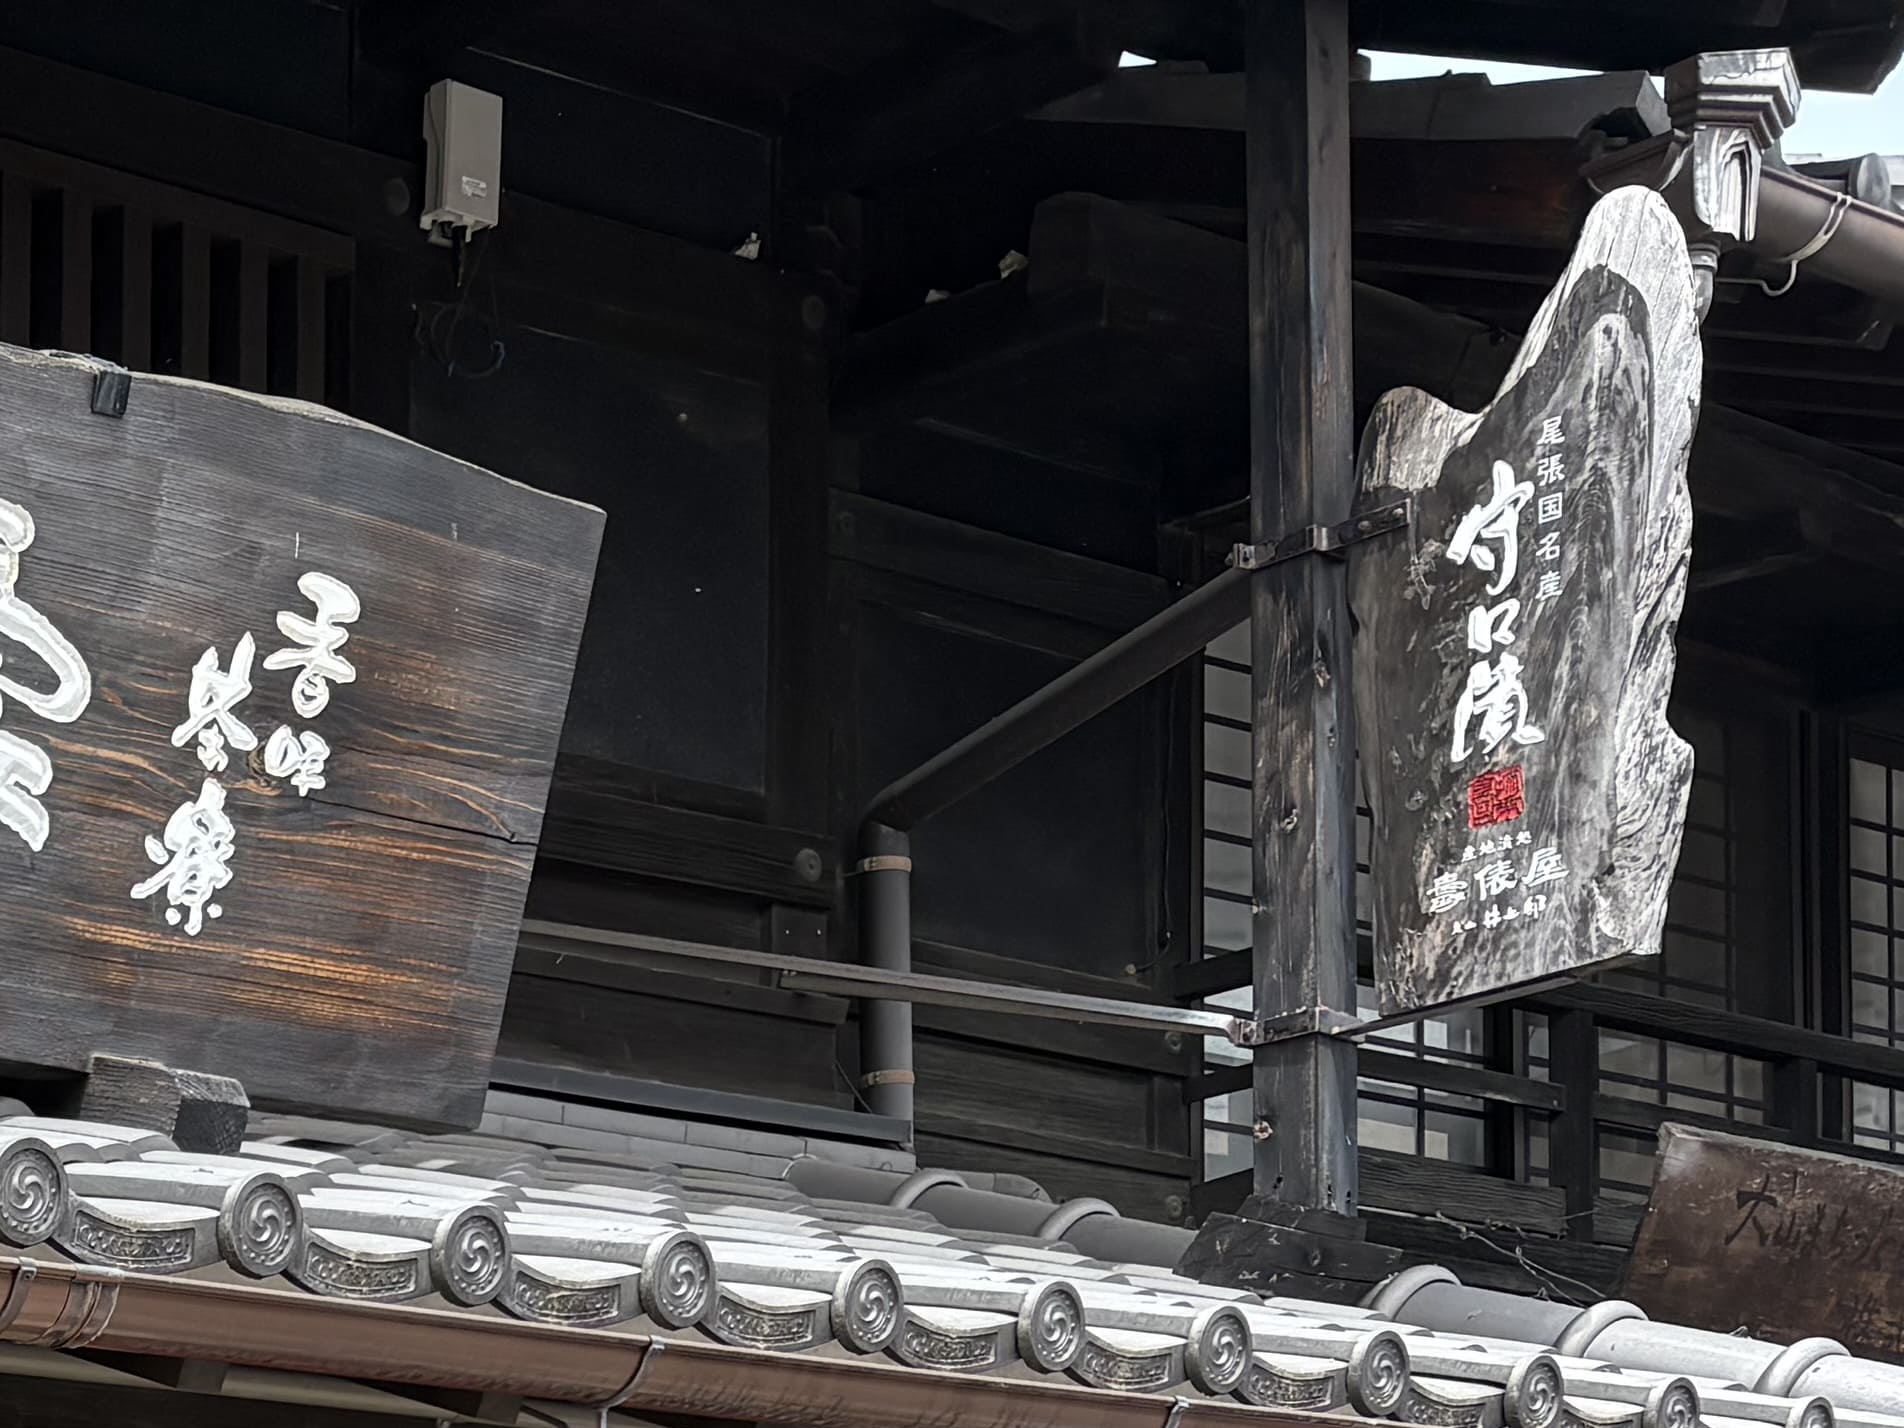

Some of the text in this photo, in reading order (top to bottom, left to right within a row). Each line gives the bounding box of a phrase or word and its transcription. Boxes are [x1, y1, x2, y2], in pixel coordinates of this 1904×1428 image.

[1445, 459, 1546, 763] 守口漬
[1535, 415, 1566, 600] 尾張国名産
